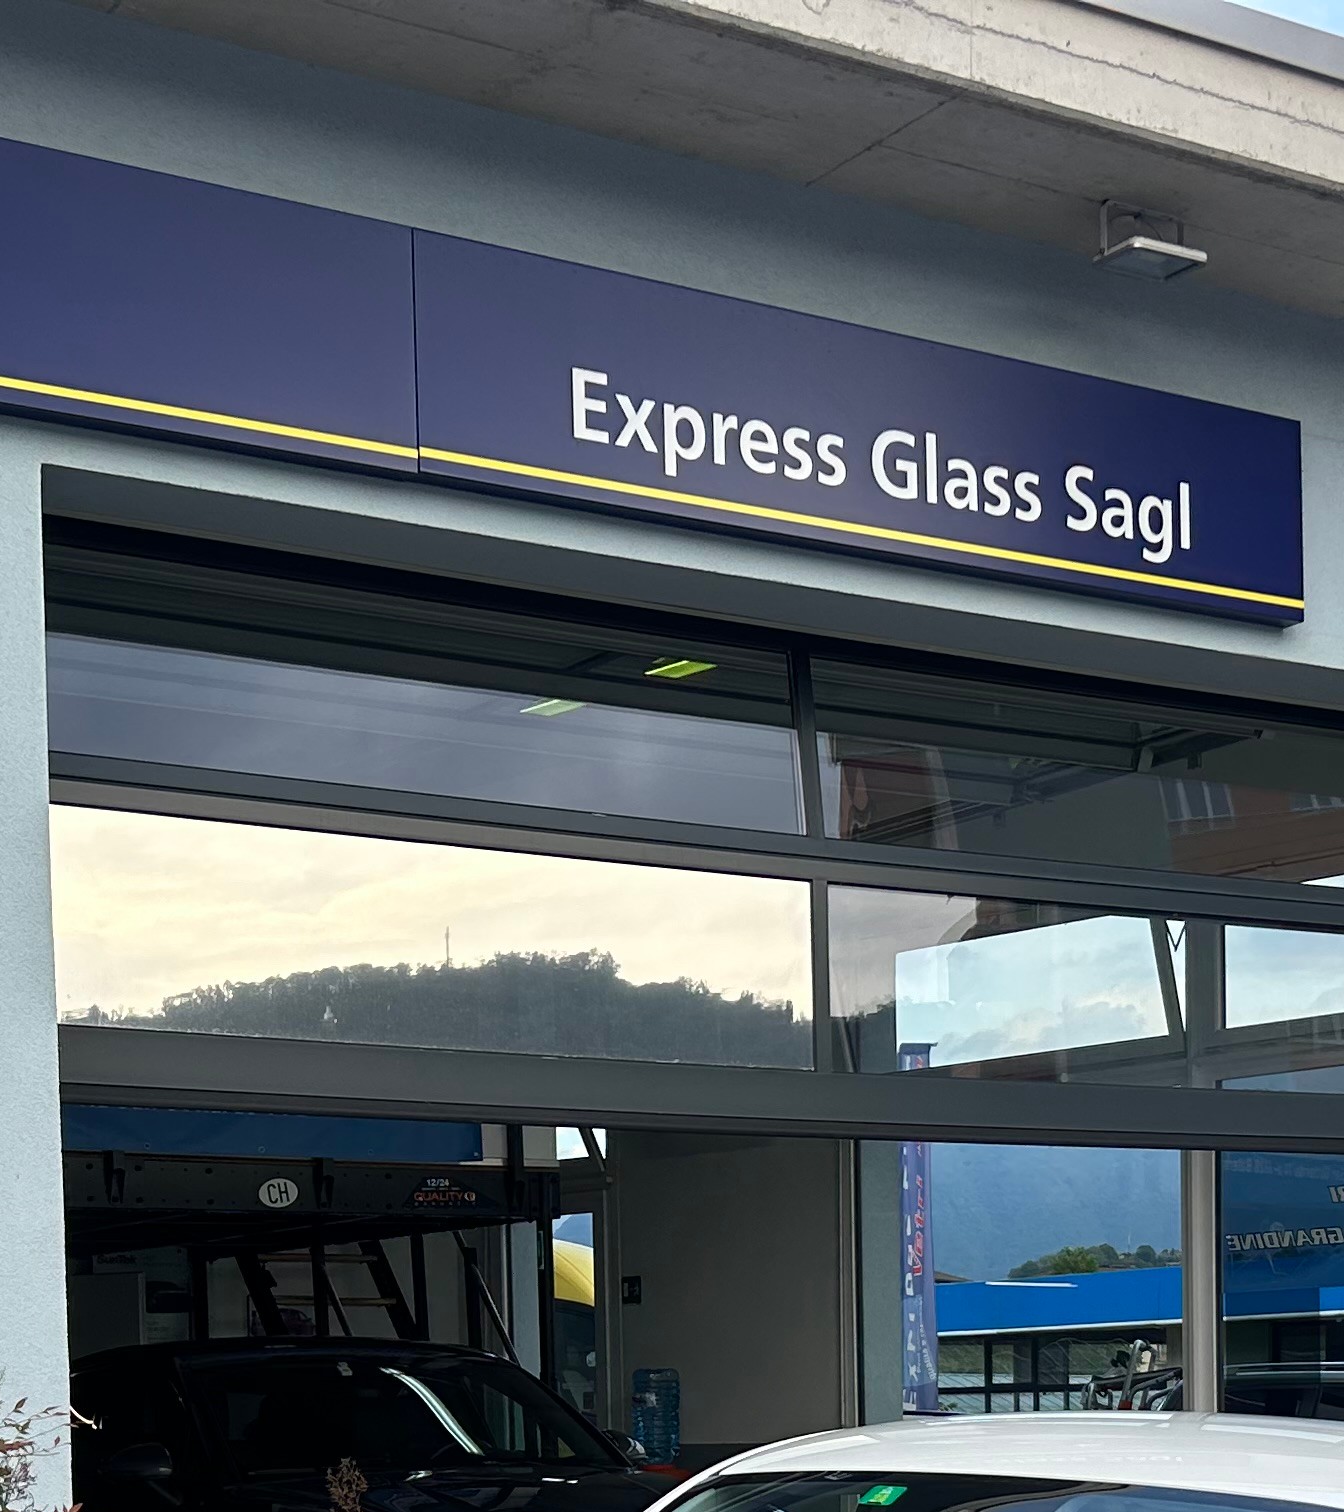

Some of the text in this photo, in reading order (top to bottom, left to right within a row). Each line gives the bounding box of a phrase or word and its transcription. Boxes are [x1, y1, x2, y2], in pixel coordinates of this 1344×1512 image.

[570, 366, 1192, 564] Express Glass Sagl
[266, 1182, 290, 1204] CH
